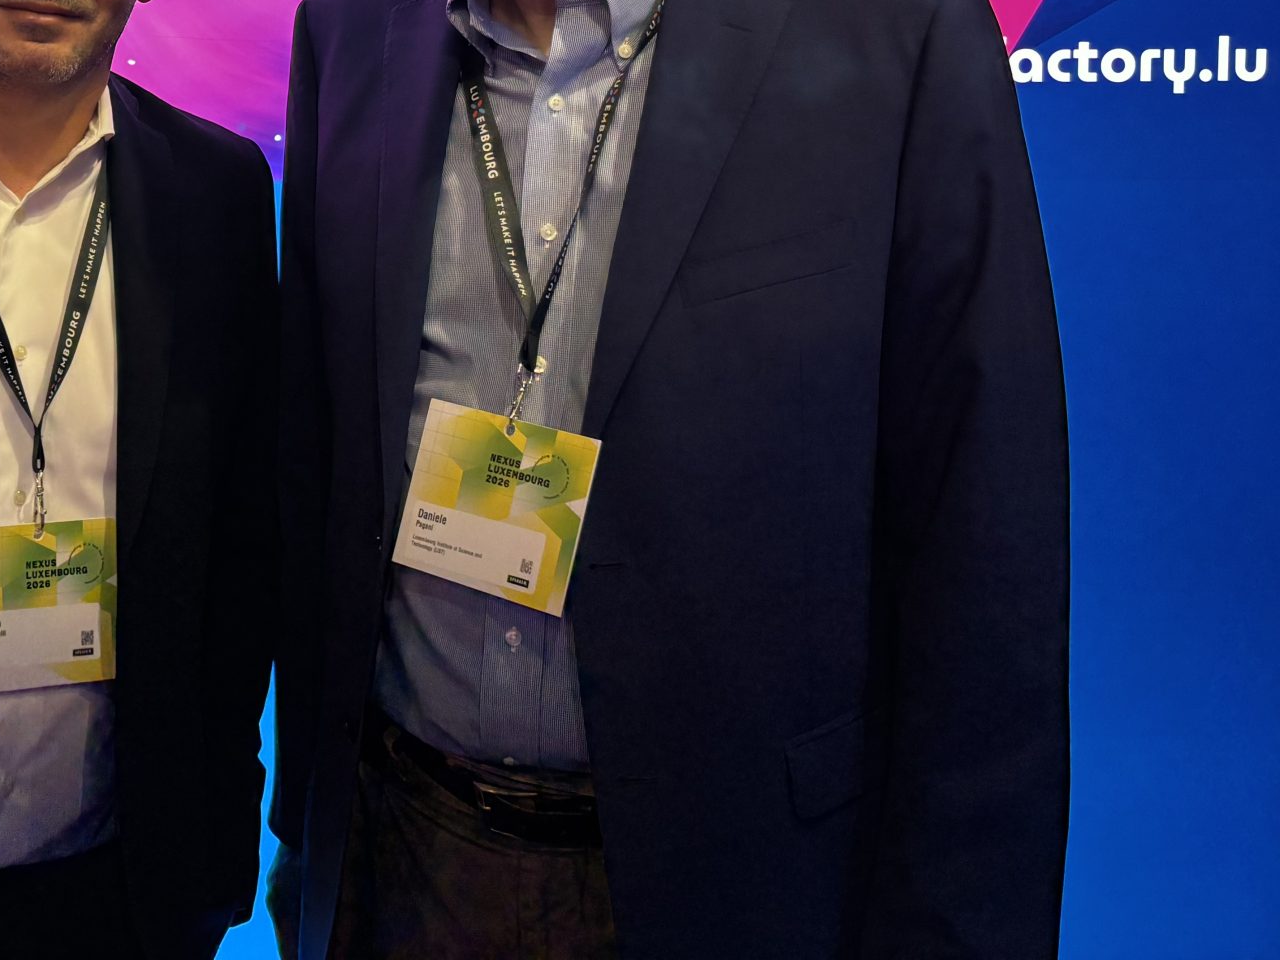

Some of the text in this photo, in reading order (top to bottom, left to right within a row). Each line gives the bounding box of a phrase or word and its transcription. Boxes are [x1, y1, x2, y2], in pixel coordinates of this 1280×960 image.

[1003, 35, 1268, 94] actory.lu
[469, 85, 499, 180] LUXEMBOURG
[79, 274, 90, 299] LET'S
[86, 247, 97, 273] MAKE
[93, 202, 106, 236] HAPPEN
[493, 191, 527, 296] LET'S MAKE IT HAPPEN
[490, 453, 522, 469] NEXUS
[486, 474, 511, 488] 2026
[487, 464, 551, 489] LUXEMBOURG
[418, 508, 447, 525] Daniele
[25, 559, 57, 569] NEXUS
[25, 566, 88, 580] LUXEMBOURG
[26, 580, 51, 589] 2026
